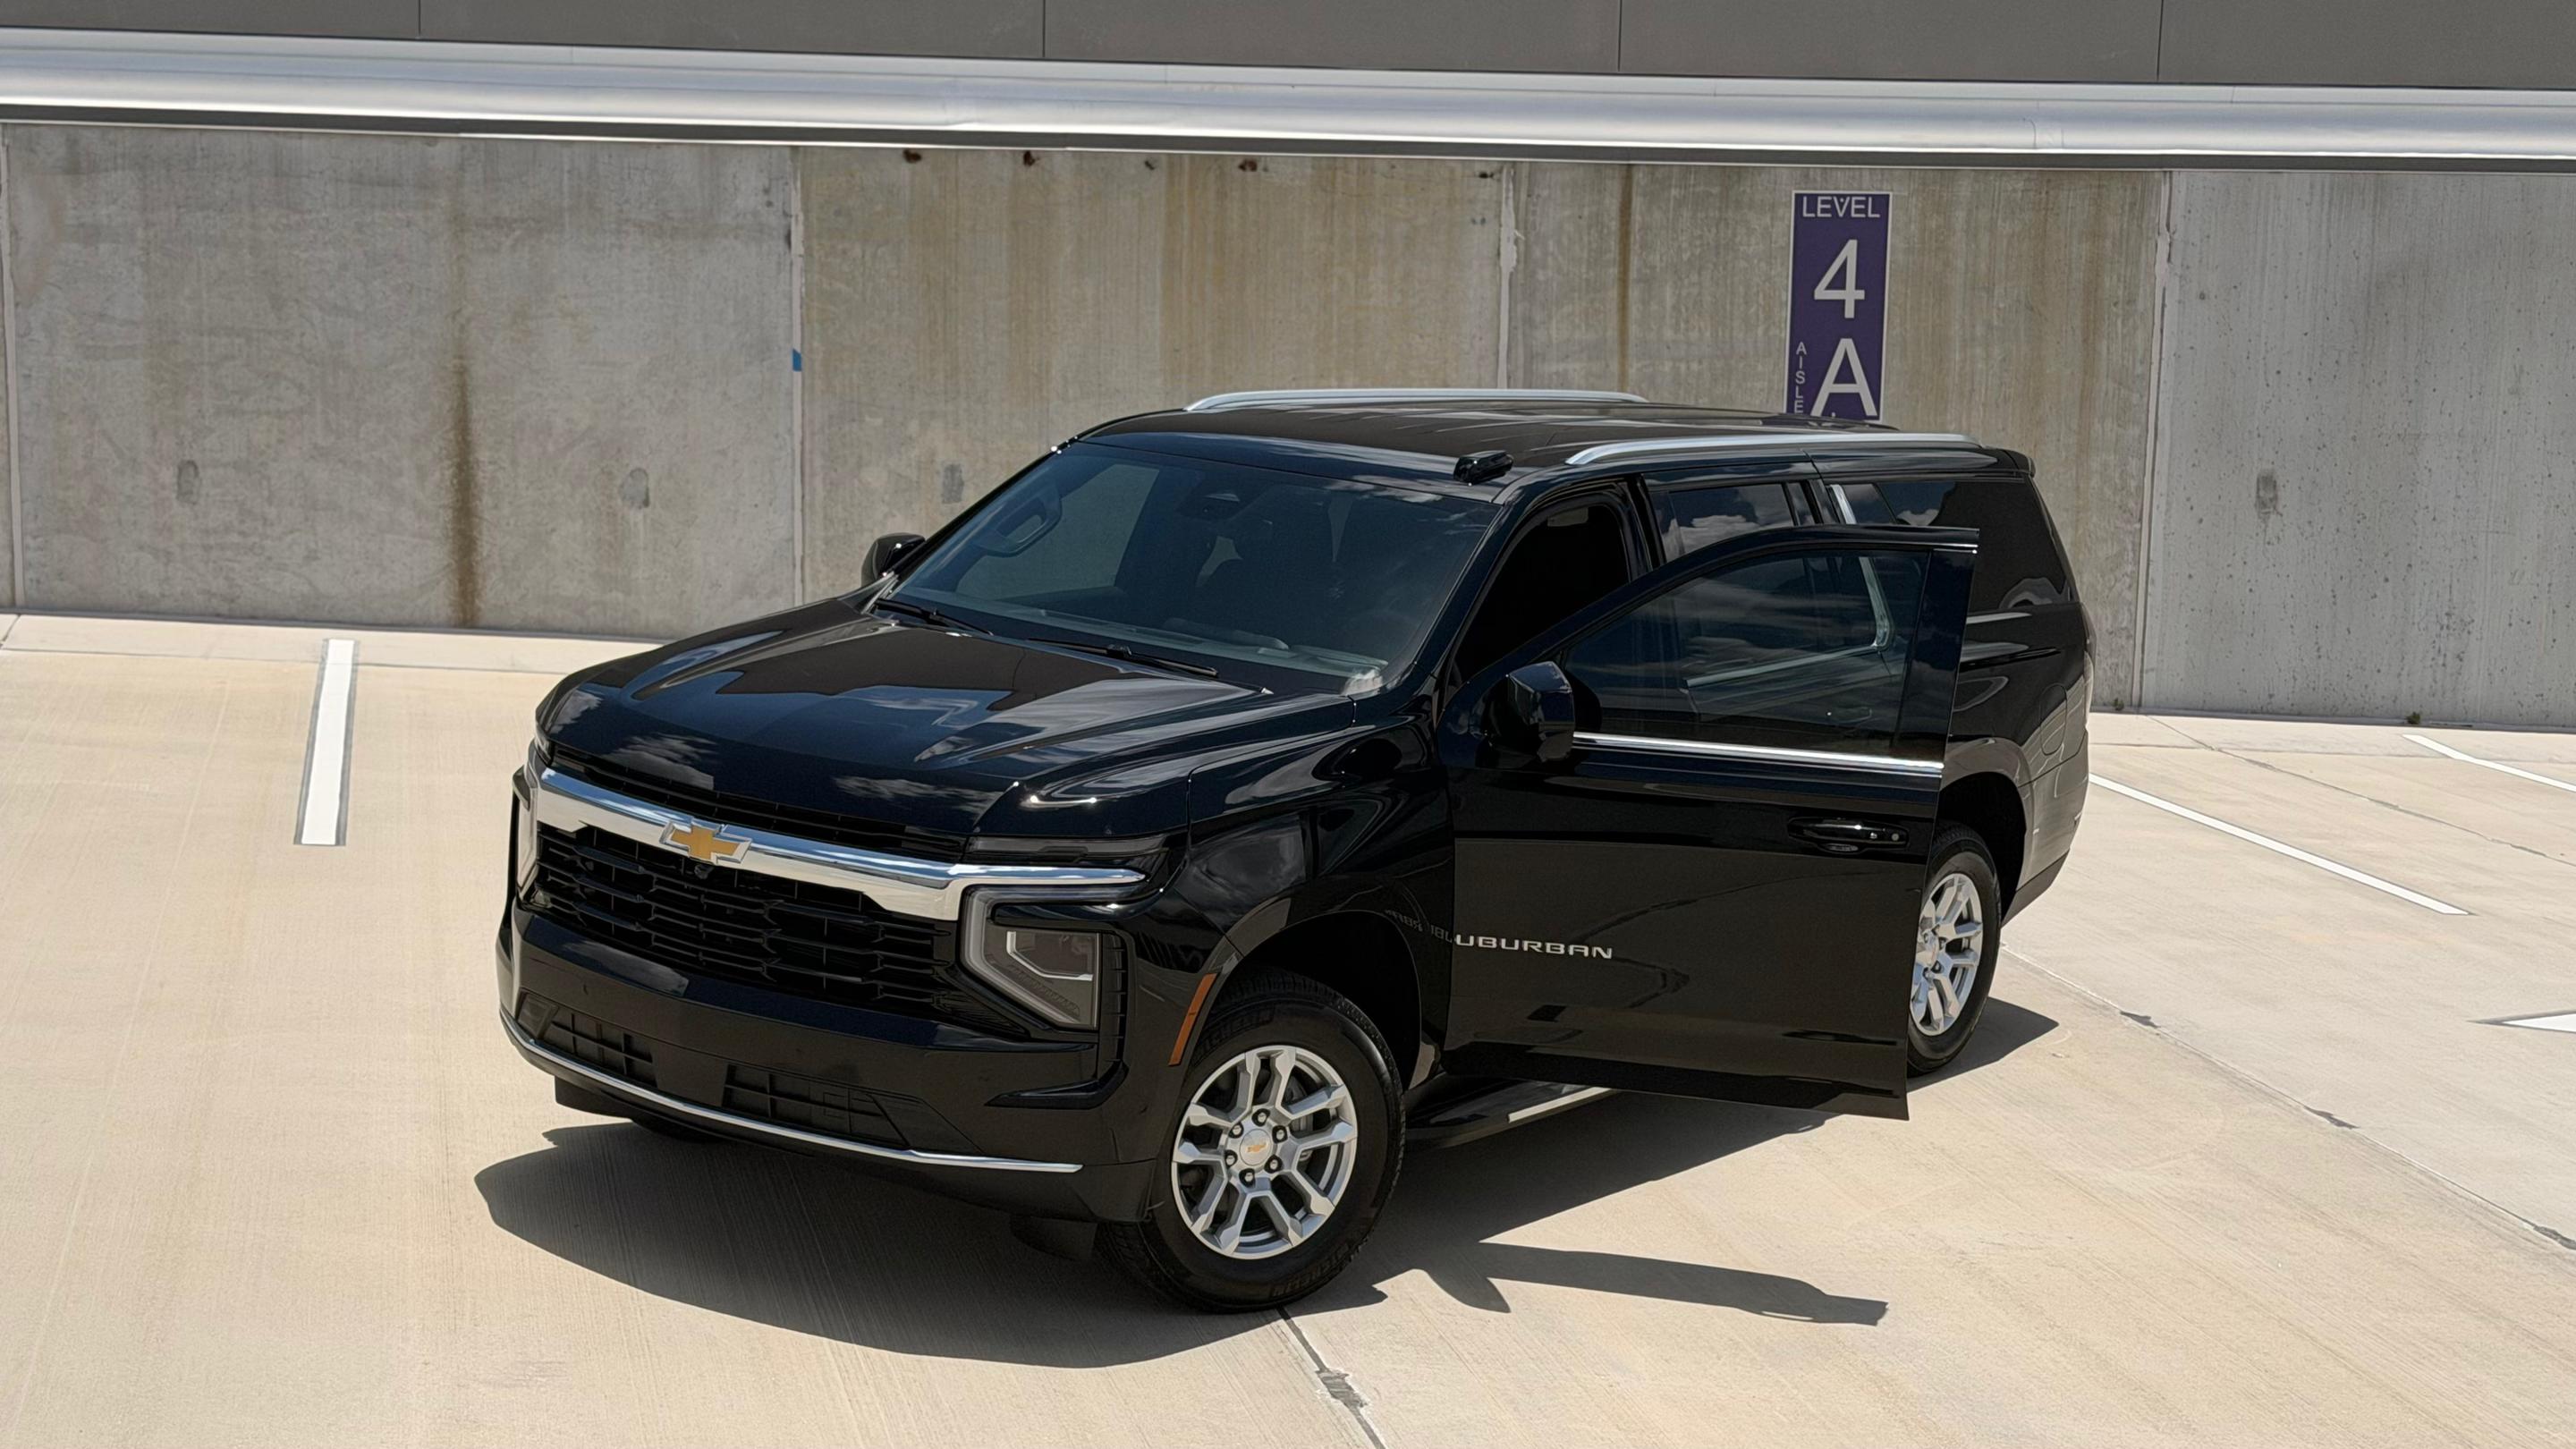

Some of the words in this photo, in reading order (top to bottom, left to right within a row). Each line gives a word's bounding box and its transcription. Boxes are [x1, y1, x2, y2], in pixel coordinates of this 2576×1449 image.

[1802, 196, 1880, 218] LEVEL
[1814, 239, 1865, 318] 4
[1793, 342, 1808, 414] AISLE
[1809, 338, 1878, 417] A
[1453, 934, 1612, 959] UBURBAN
